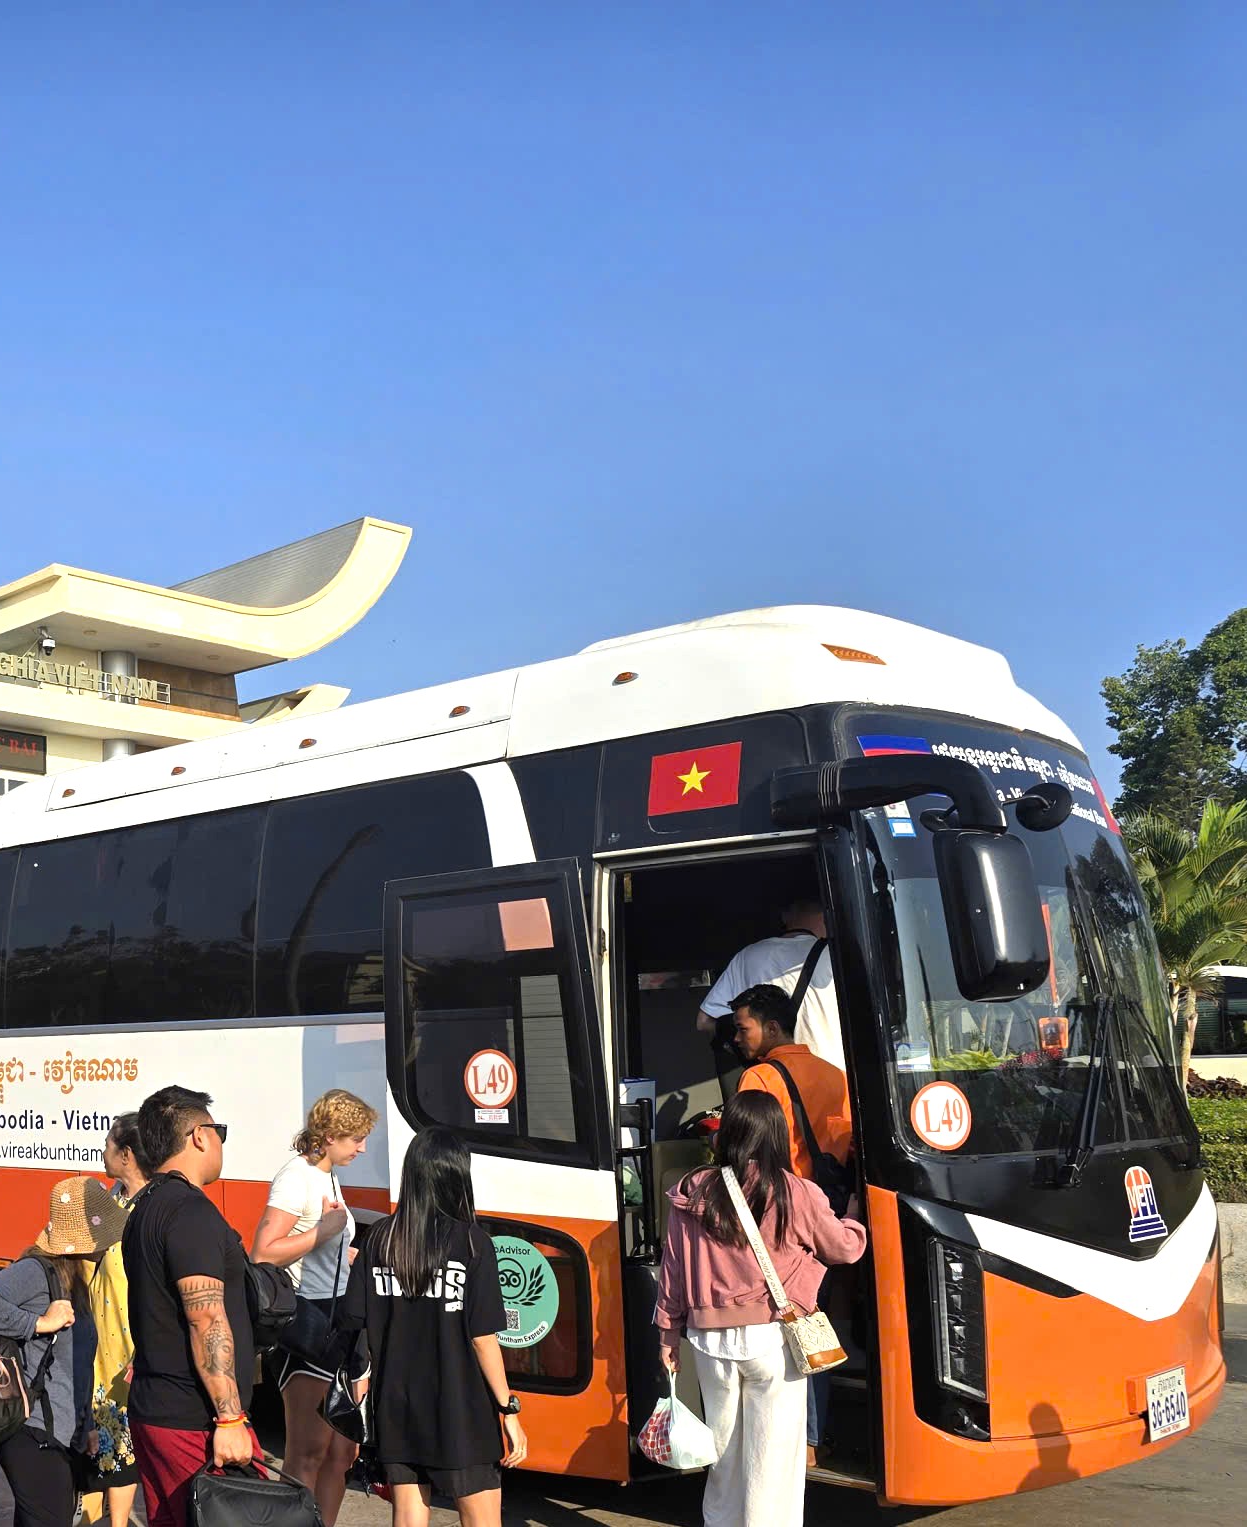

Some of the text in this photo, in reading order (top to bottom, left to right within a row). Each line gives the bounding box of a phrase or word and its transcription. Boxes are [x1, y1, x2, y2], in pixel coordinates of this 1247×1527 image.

[54, 661, 102, 695] VIỆT
[111, 674, 158, 701] NAM
[472, 1064, 509, 1095] L49
[63, 1110, 113, 1131] Vietn
[921, 1098, 964, 1133] L49
[494, 1245, 531, 1256] pAdvisor
[523, 1324, 546, 1343] Express
